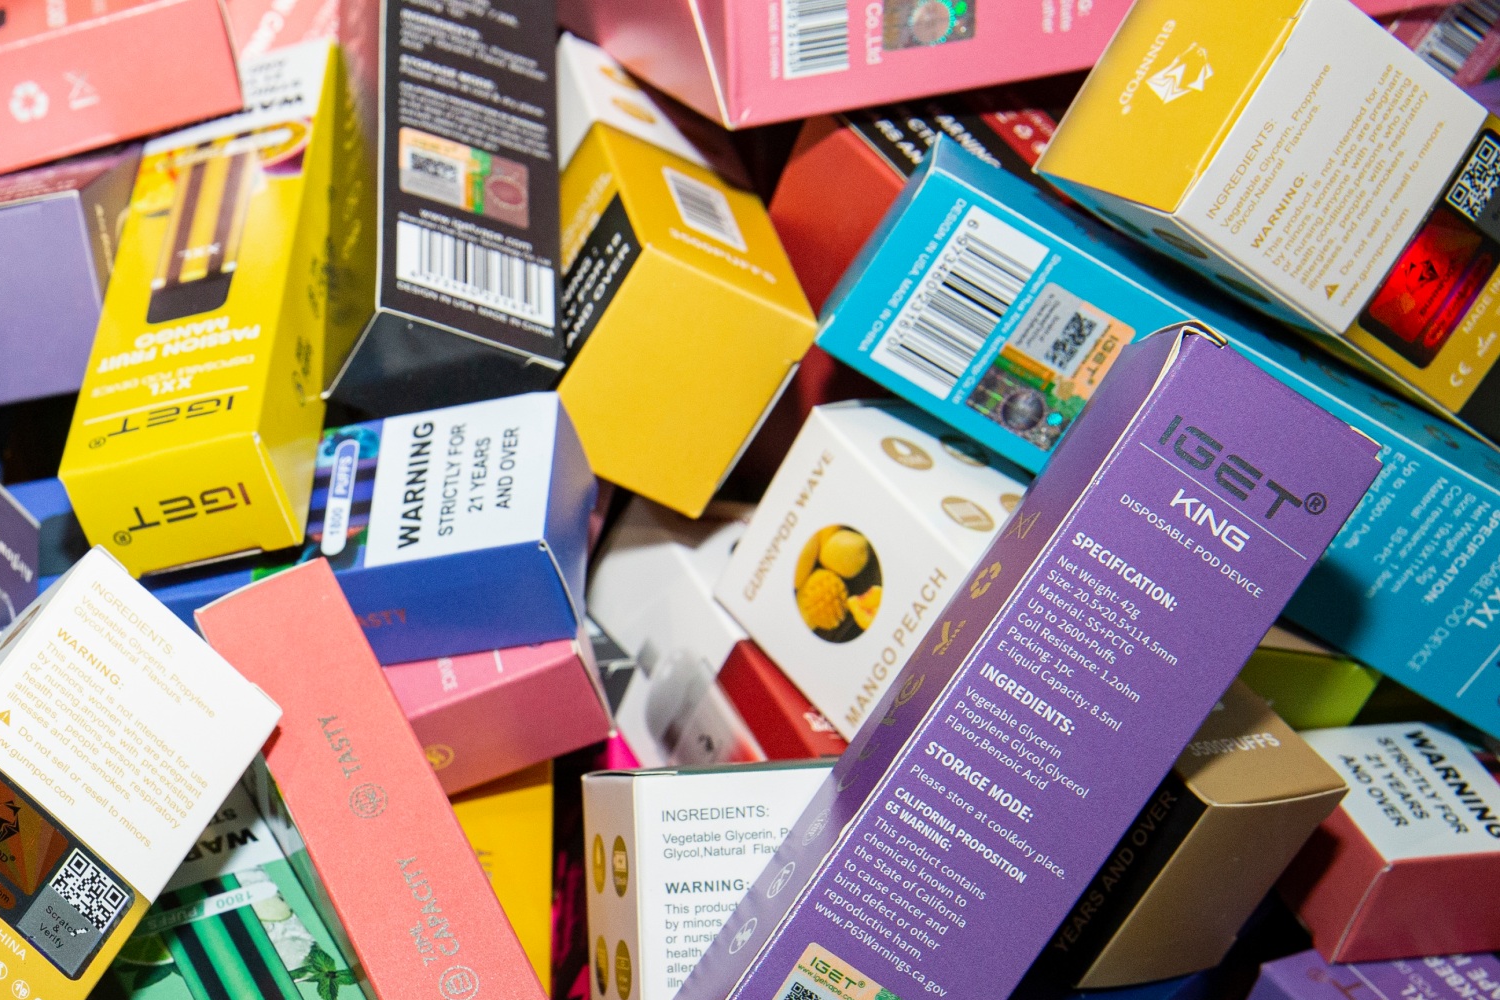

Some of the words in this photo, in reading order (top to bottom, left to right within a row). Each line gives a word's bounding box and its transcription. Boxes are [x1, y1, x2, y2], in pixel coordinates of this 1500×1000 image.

[1119, 19, 1176, 105] GUNNPOD
[1206, 119, 1277, 219] INGREDIENTS:
[1251, 172, 1308, 249] WARNING:
[161, 324, 261, 358] PASSION
[148, 375, 194, 397] XXL
[449, 423, 467, 457] FOR
[470, 437, 491, 492] YEARS
[500, 427, 520, 471] OVER
[397, 421, 434, 550] WARNING
[438, 461, 461, 537] STRICTLY
[468, 498, 483, 513] 21
[496, 476, 513, 509] AND
[1119, 493, 1194, 550] DISPOSABLE
[1194, 545, 1221, 568] POD
[1220, 562, 1264, 599] DEVICE
[1170, 488, 1250, 553] KING
[743, 511, 798, 602] GUNNPOD
[892, 568, 948, 647] PEACH
[1037, 584, 1085, 621] Material:
[1084, 616, 1135, 657] SS+PCTG
[1057, 617, 1117, 666] 2600+Puffs
[979, 662, 1076, 736] INGREDIENTS:
[996, 640, 1041, 677] E-liquid
[1089, 704, 1123, 732] 8.5ml
[1099, 669, 1142, 704] 1.2ohm
[317, 714, 363, 779] TASTY
[954, 700, 1010, 744] Propylene
[965, 685, 1018, 729] Vegetable
[1017, 722, 1062, 759] Glycerin
[1187, 733, 1280, 756] 3500PUFFS
[910, 764, 947, 794] Please
[924, 741, 990, 792] STORAGE
[987, 784, 1035, 823] MODE:
[1340, 754, 1371, 788] AND
[1367, 788, 1409, 828] OVER
[1378, 737, 1441, 803] STRICTLY
[1435, 800, 1469, 834] FOR
[1381, 772, 1429, 820] YEARS
[1404, 730, 1500, 838] WARNING
[663, 832, 721, 846] Vegetable
[894, 787, 957, 836] CALIFORNIA
[954, 829, 1028, 884] PROPOSITION
[896, 833, 942, 869] product
[940, 864, 987, 901] contains
[397, 855, 460, 957] CAPACITY
[824, 887, 893, 940] reproductive
[915, 887, 967, 929] California
